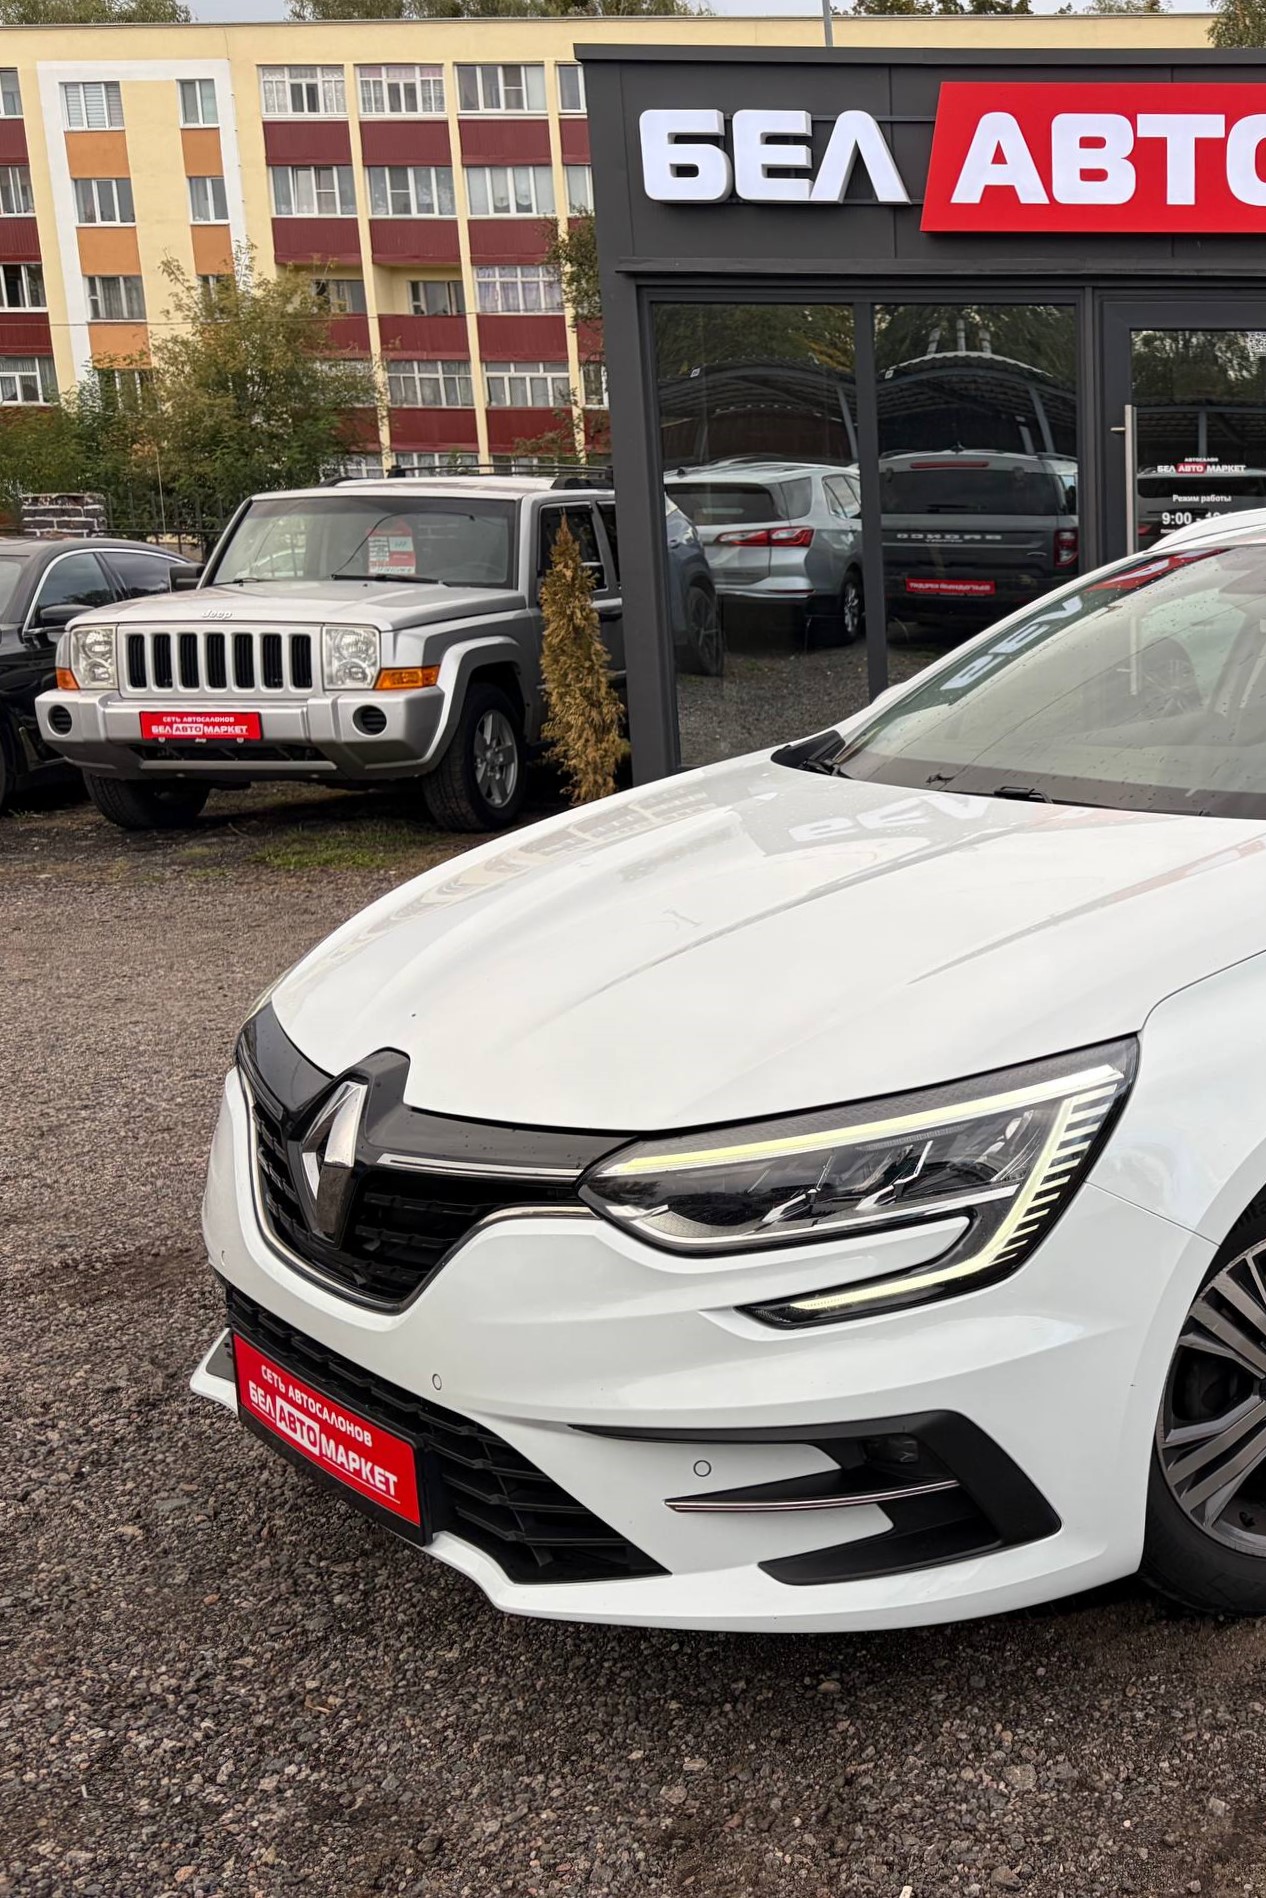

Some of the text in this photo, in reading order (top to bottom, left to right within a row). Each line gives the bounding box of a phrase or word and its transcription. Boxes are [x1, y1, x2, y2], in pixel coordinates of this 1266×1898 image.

[639, 109, 911, 204] БЕЛ
[1157, 465, 1246, 473] БЕЛ АВТО МАРКЕТ
[1172, 494, 1231, 504] Режим работы
[1162, 512, 1192, 525] 9:00
[201, 609, 233, 619] Jeep
[152, 725, 248, 735] БЕЛ АВТО МАРКЕТ
[261, 1364, 373, 1448] СЕТЬ АВТОСАЛОНОВ
[249, 1379, 398, 1497] БЕЛ АВТО МАРКЕТ
